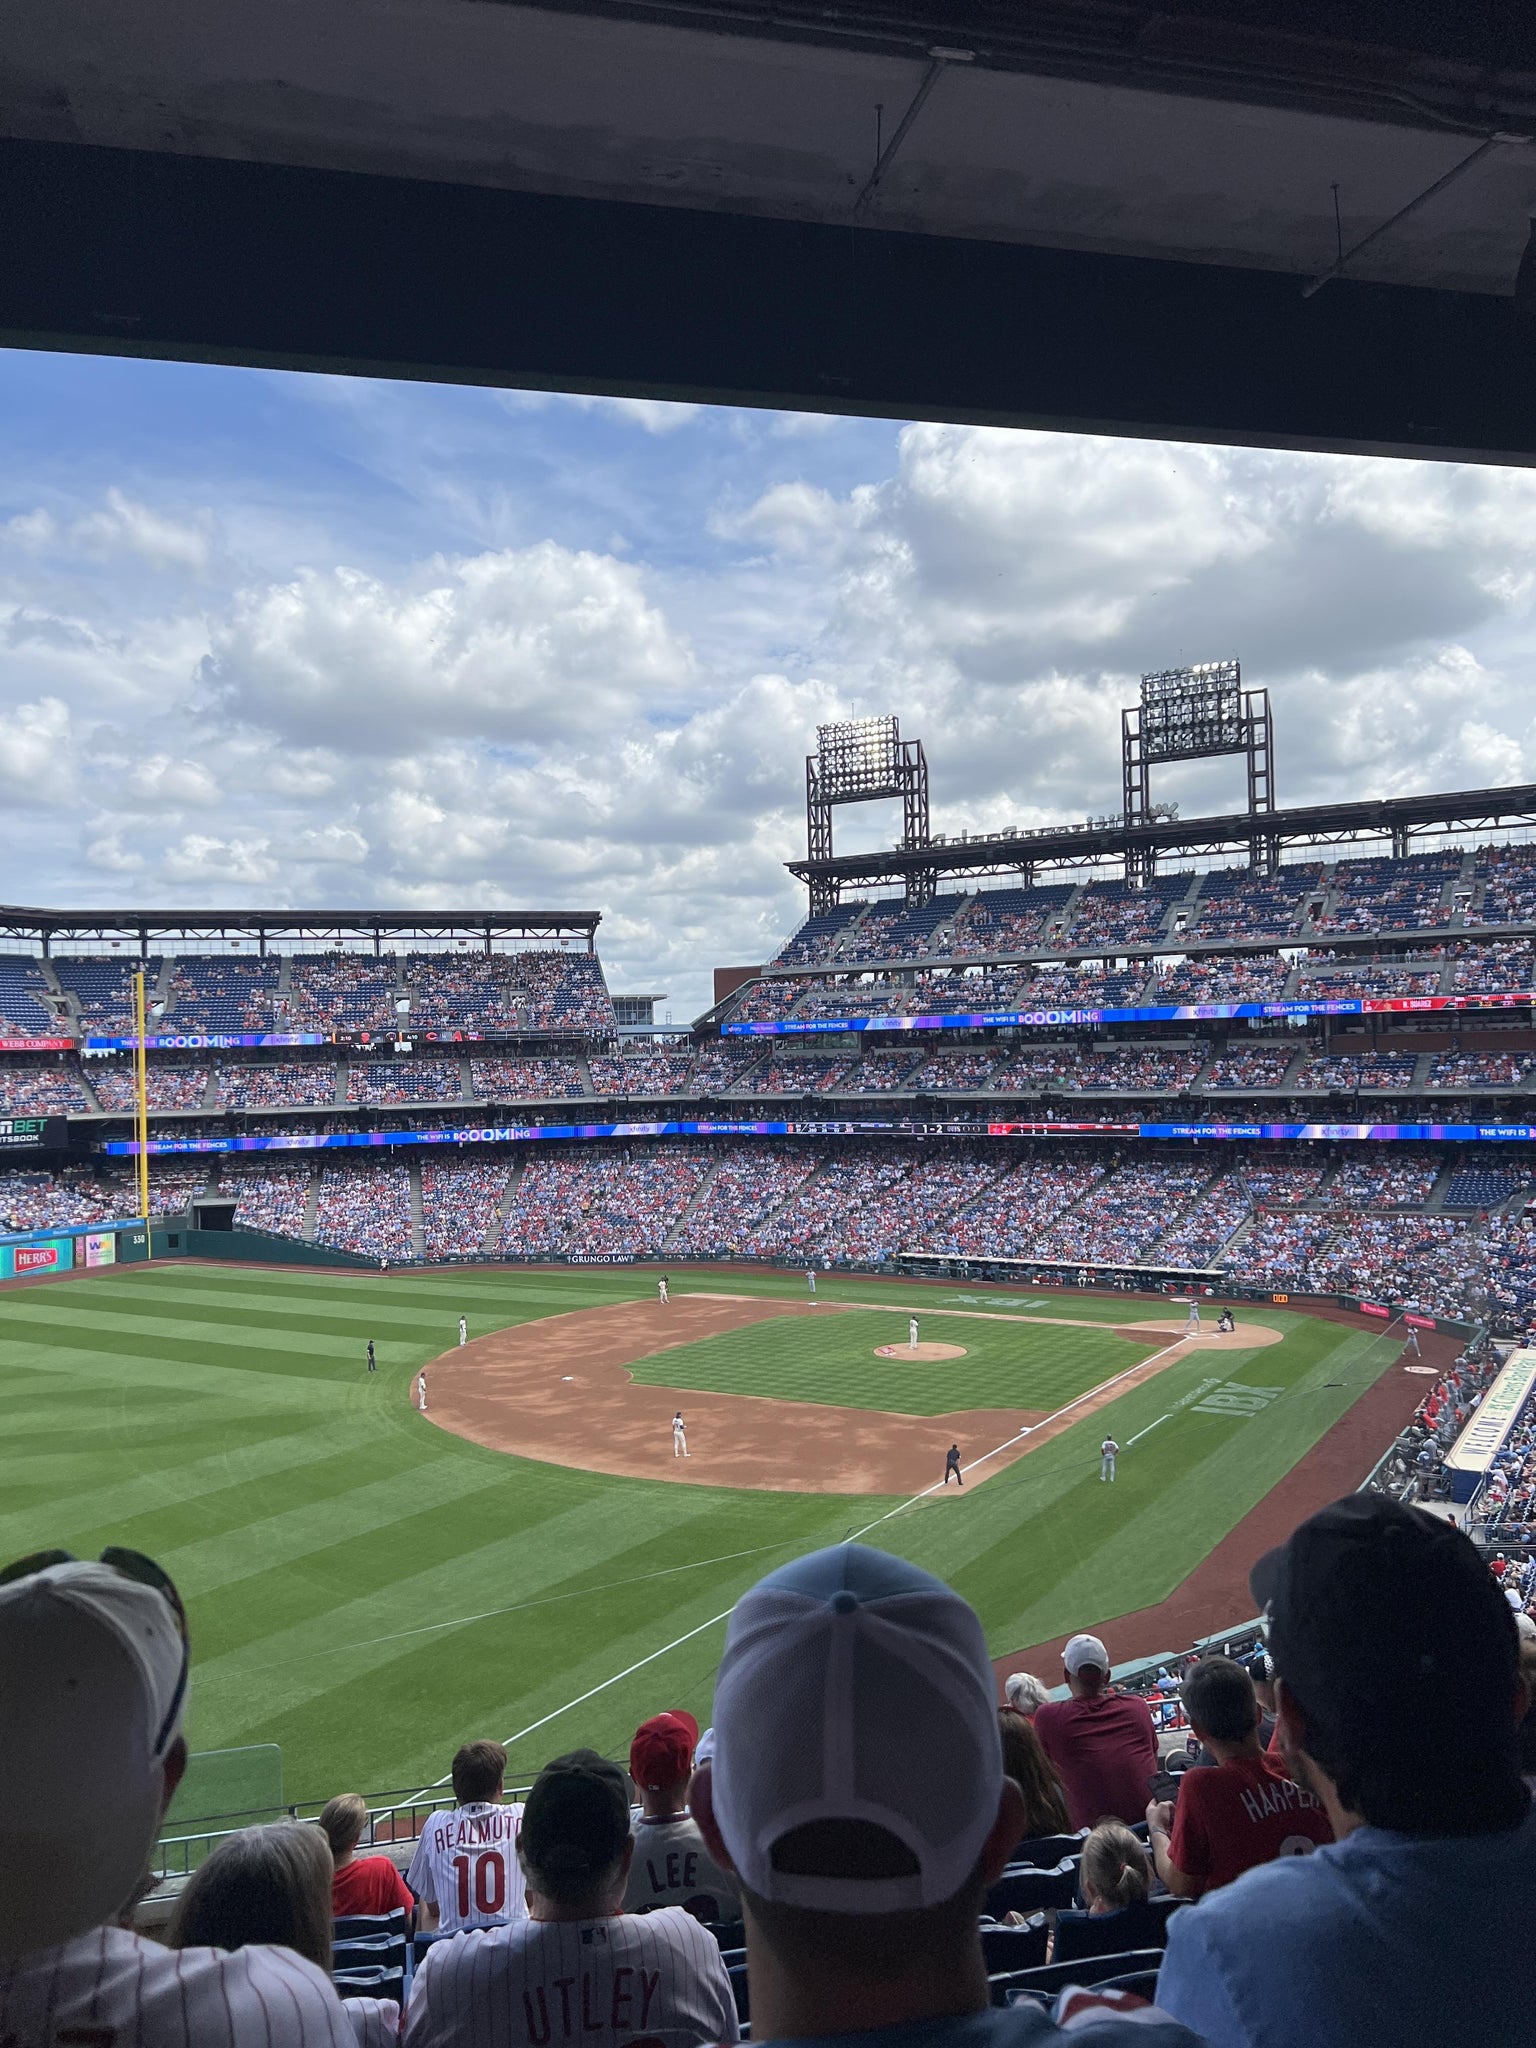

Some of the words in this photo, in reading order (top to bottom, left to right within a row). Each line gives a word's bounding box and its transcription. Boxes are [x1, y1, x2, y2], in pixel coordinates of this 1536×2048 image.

[1310, 1004, 1325, 1012] THE
[1326, 1003, 1356, 1011] FENCES
[1018, 1010, 1099, 1024] BOOOMING
[784, 1023, 805, 1031] STREAM
[2, 1040, 25, 1048] WEBB
[26, 1039, 65, 1048] COMPANY
[159, 1035, 241, 1048] BOOOMING
[453, 1128, 531, 1142] BOOOMING
[1479, 1128, 1497, 1136] THE
[1498, 1128, 1517, 1136] WIFI
[1518, 1128, 1527, 1136] IS
[18, 1251, 52, 1265] HERR'S
[571, 1255, 610, 1263] GRUNGO
[1189, 1381, 1286, 1417] IBX
[1459, 1415, 1507, 1455] WELCOME
[646, 1852, 698, 1893] LEE
[452, 1851, 505, 1918] 10
[522, 1966, 660, 2046] UTLEY
